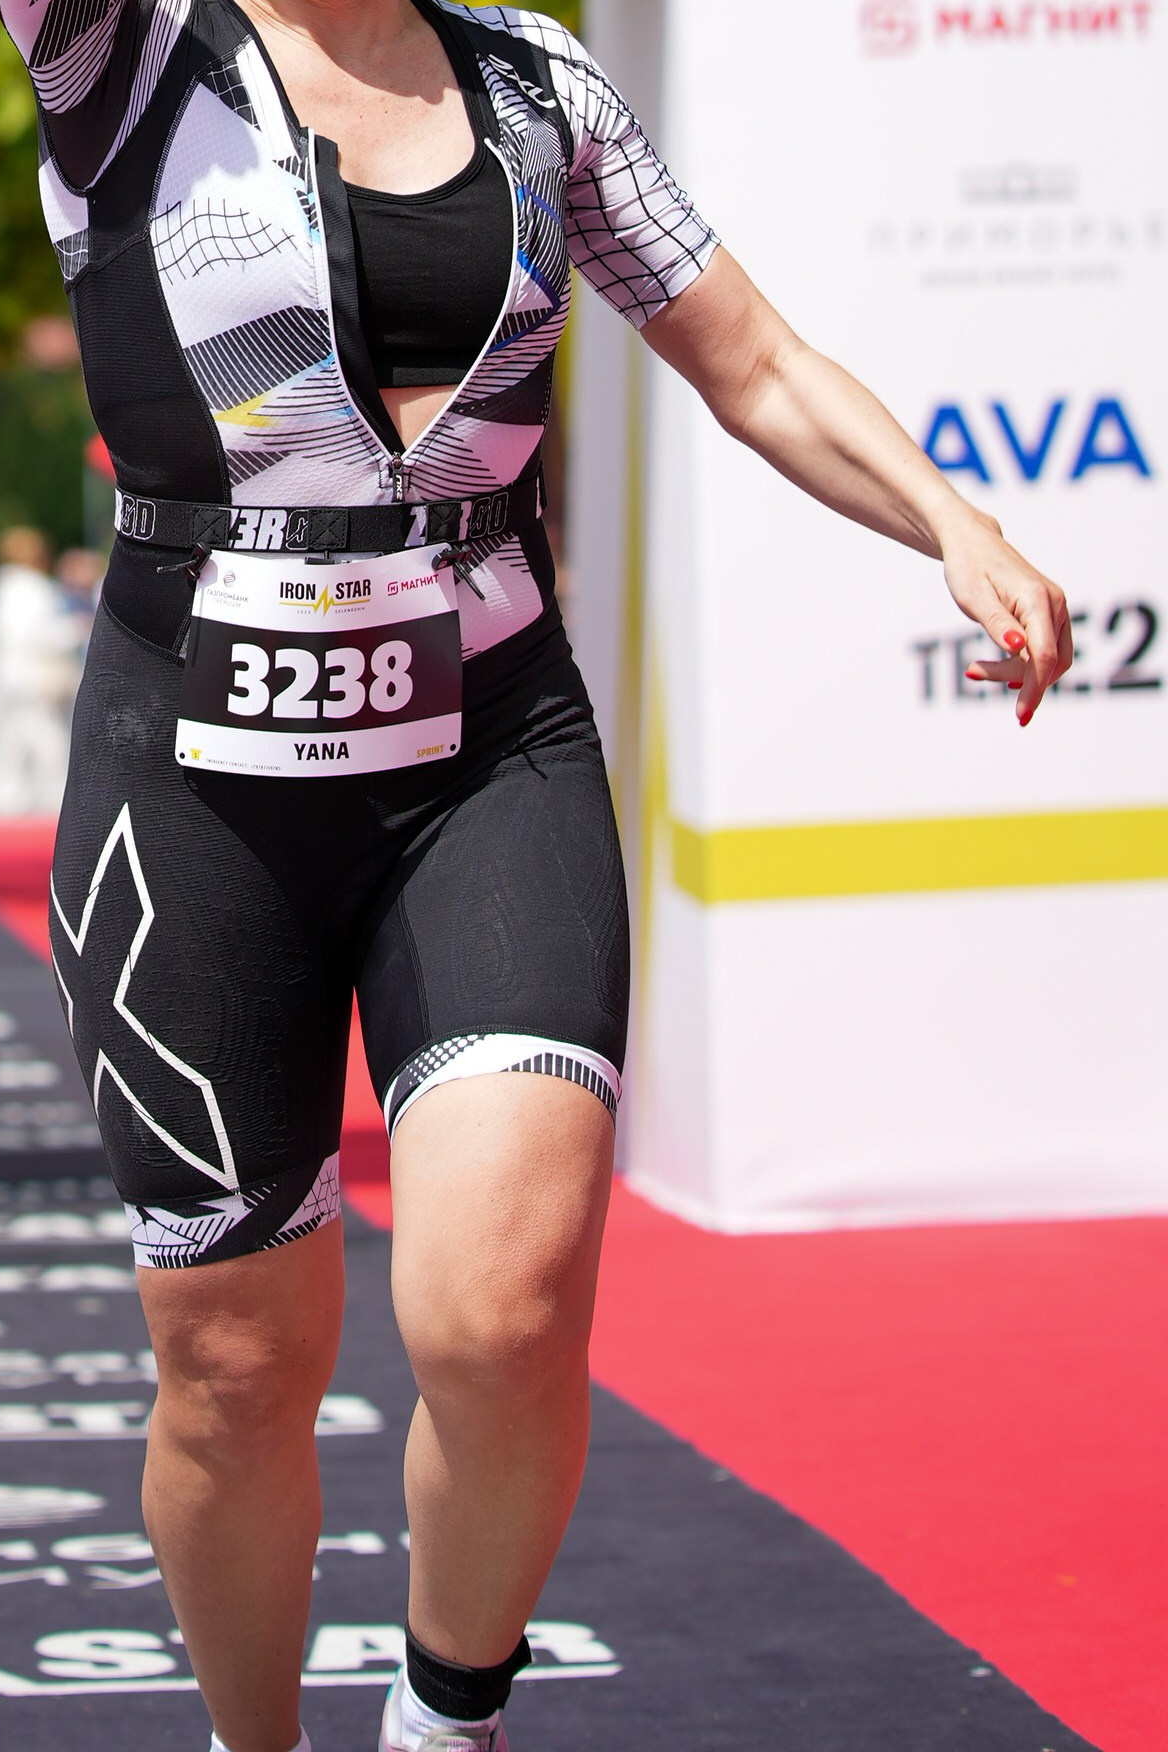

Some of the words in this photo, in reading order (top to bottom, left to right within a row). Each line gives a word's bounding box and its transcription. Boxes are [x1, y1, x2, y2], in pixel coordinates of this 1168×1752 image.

[923, 397, 1151, 484] AVA
[279, 581, 316, 601] IRON
[335, 578, 371, 600] STAR
[401, 573, 440, 592] МАГНИТ
[227, 640, 414, 719] 3238
[294, 741, 350, 761] YANA
[416, 744, 445, 759] SPRINT
